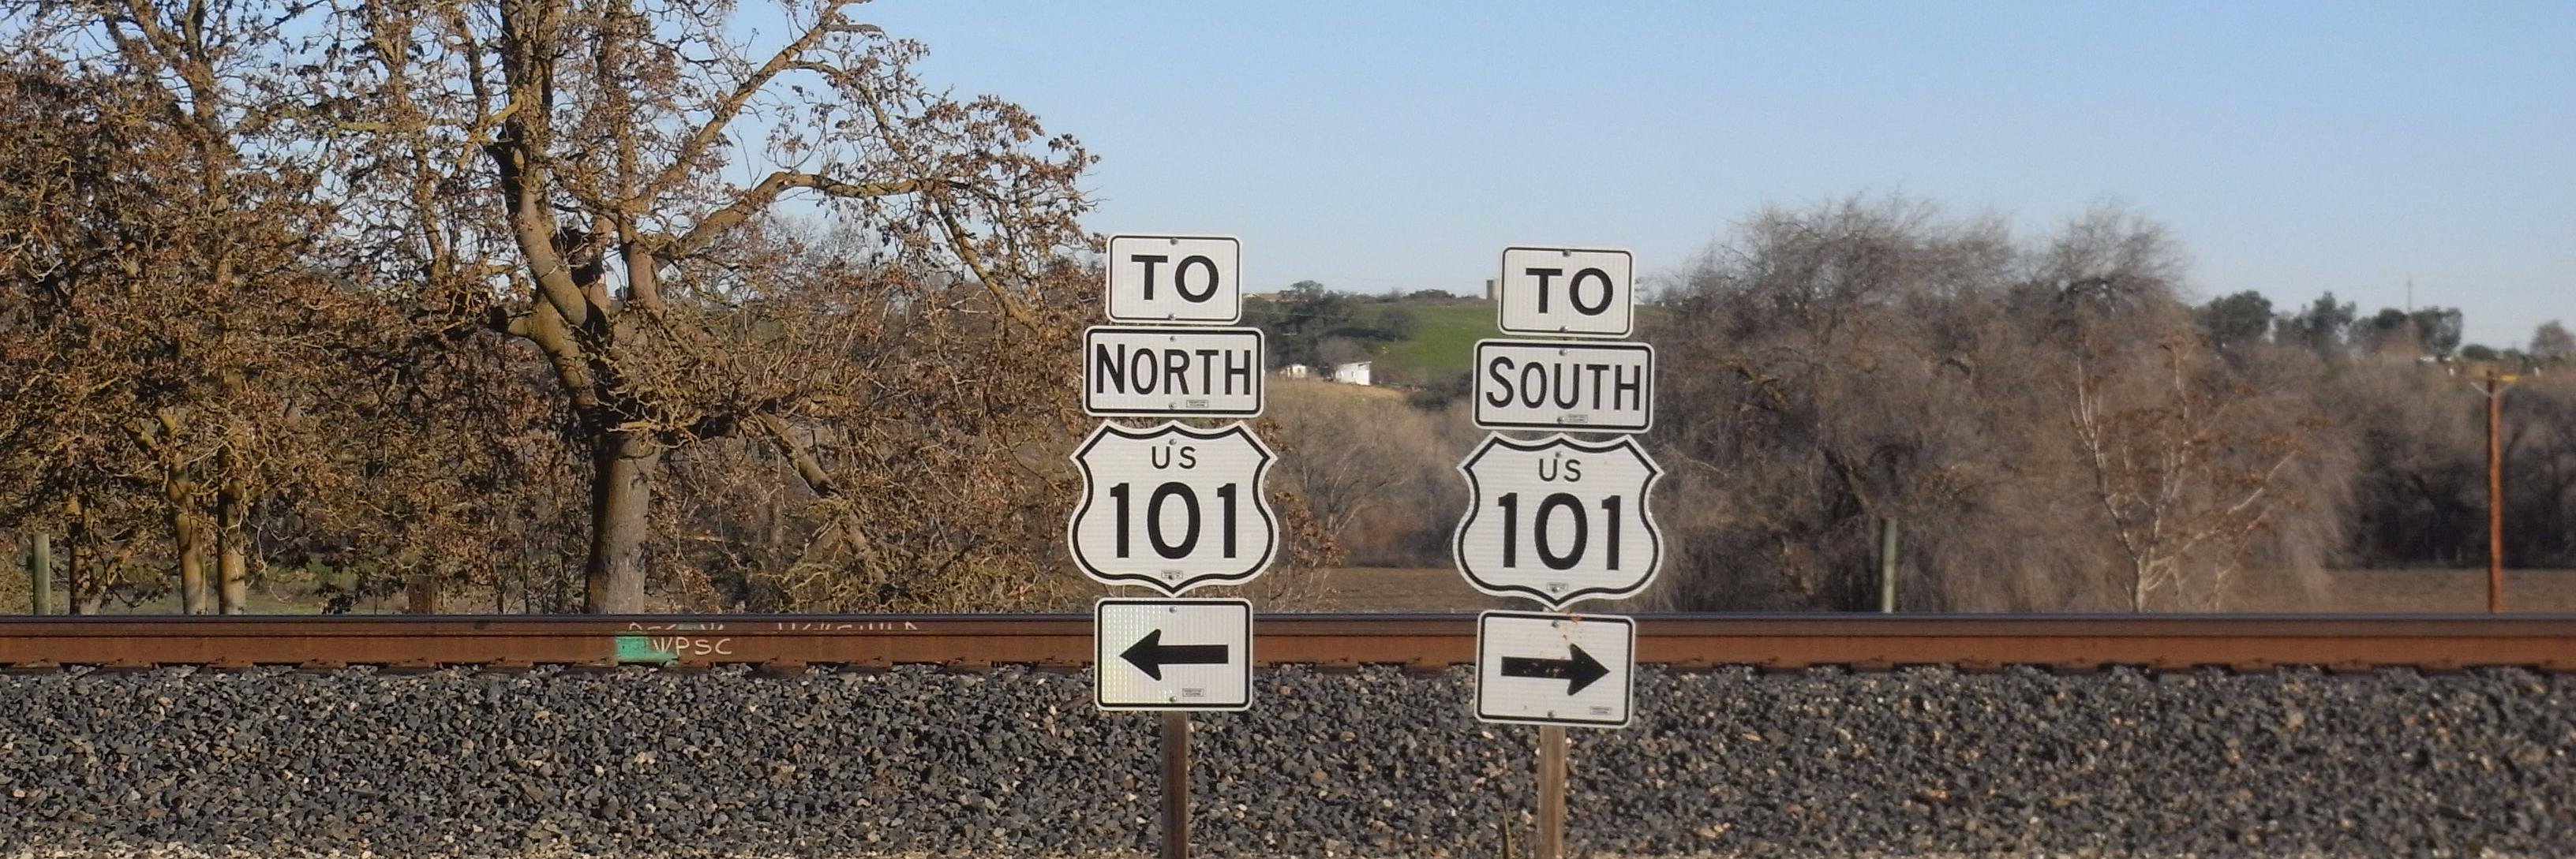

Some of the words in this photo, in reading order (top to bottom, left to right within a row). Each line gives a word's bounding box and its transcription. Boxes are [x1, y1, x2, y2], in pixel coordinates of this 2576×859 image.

[1131, 255, 1219, 303] TO
[1526, 267, 1614, 316] TO
[1096, 343, 1251, 395] NORTH
[1485, 356, 1641, 411] SOUTH
[1151, 446, 1196, 469] US
[1539, 458, 1582, 482] US
[1110, 481, 1237, 560] 101
[1498, 492, 1621, 571] 101
